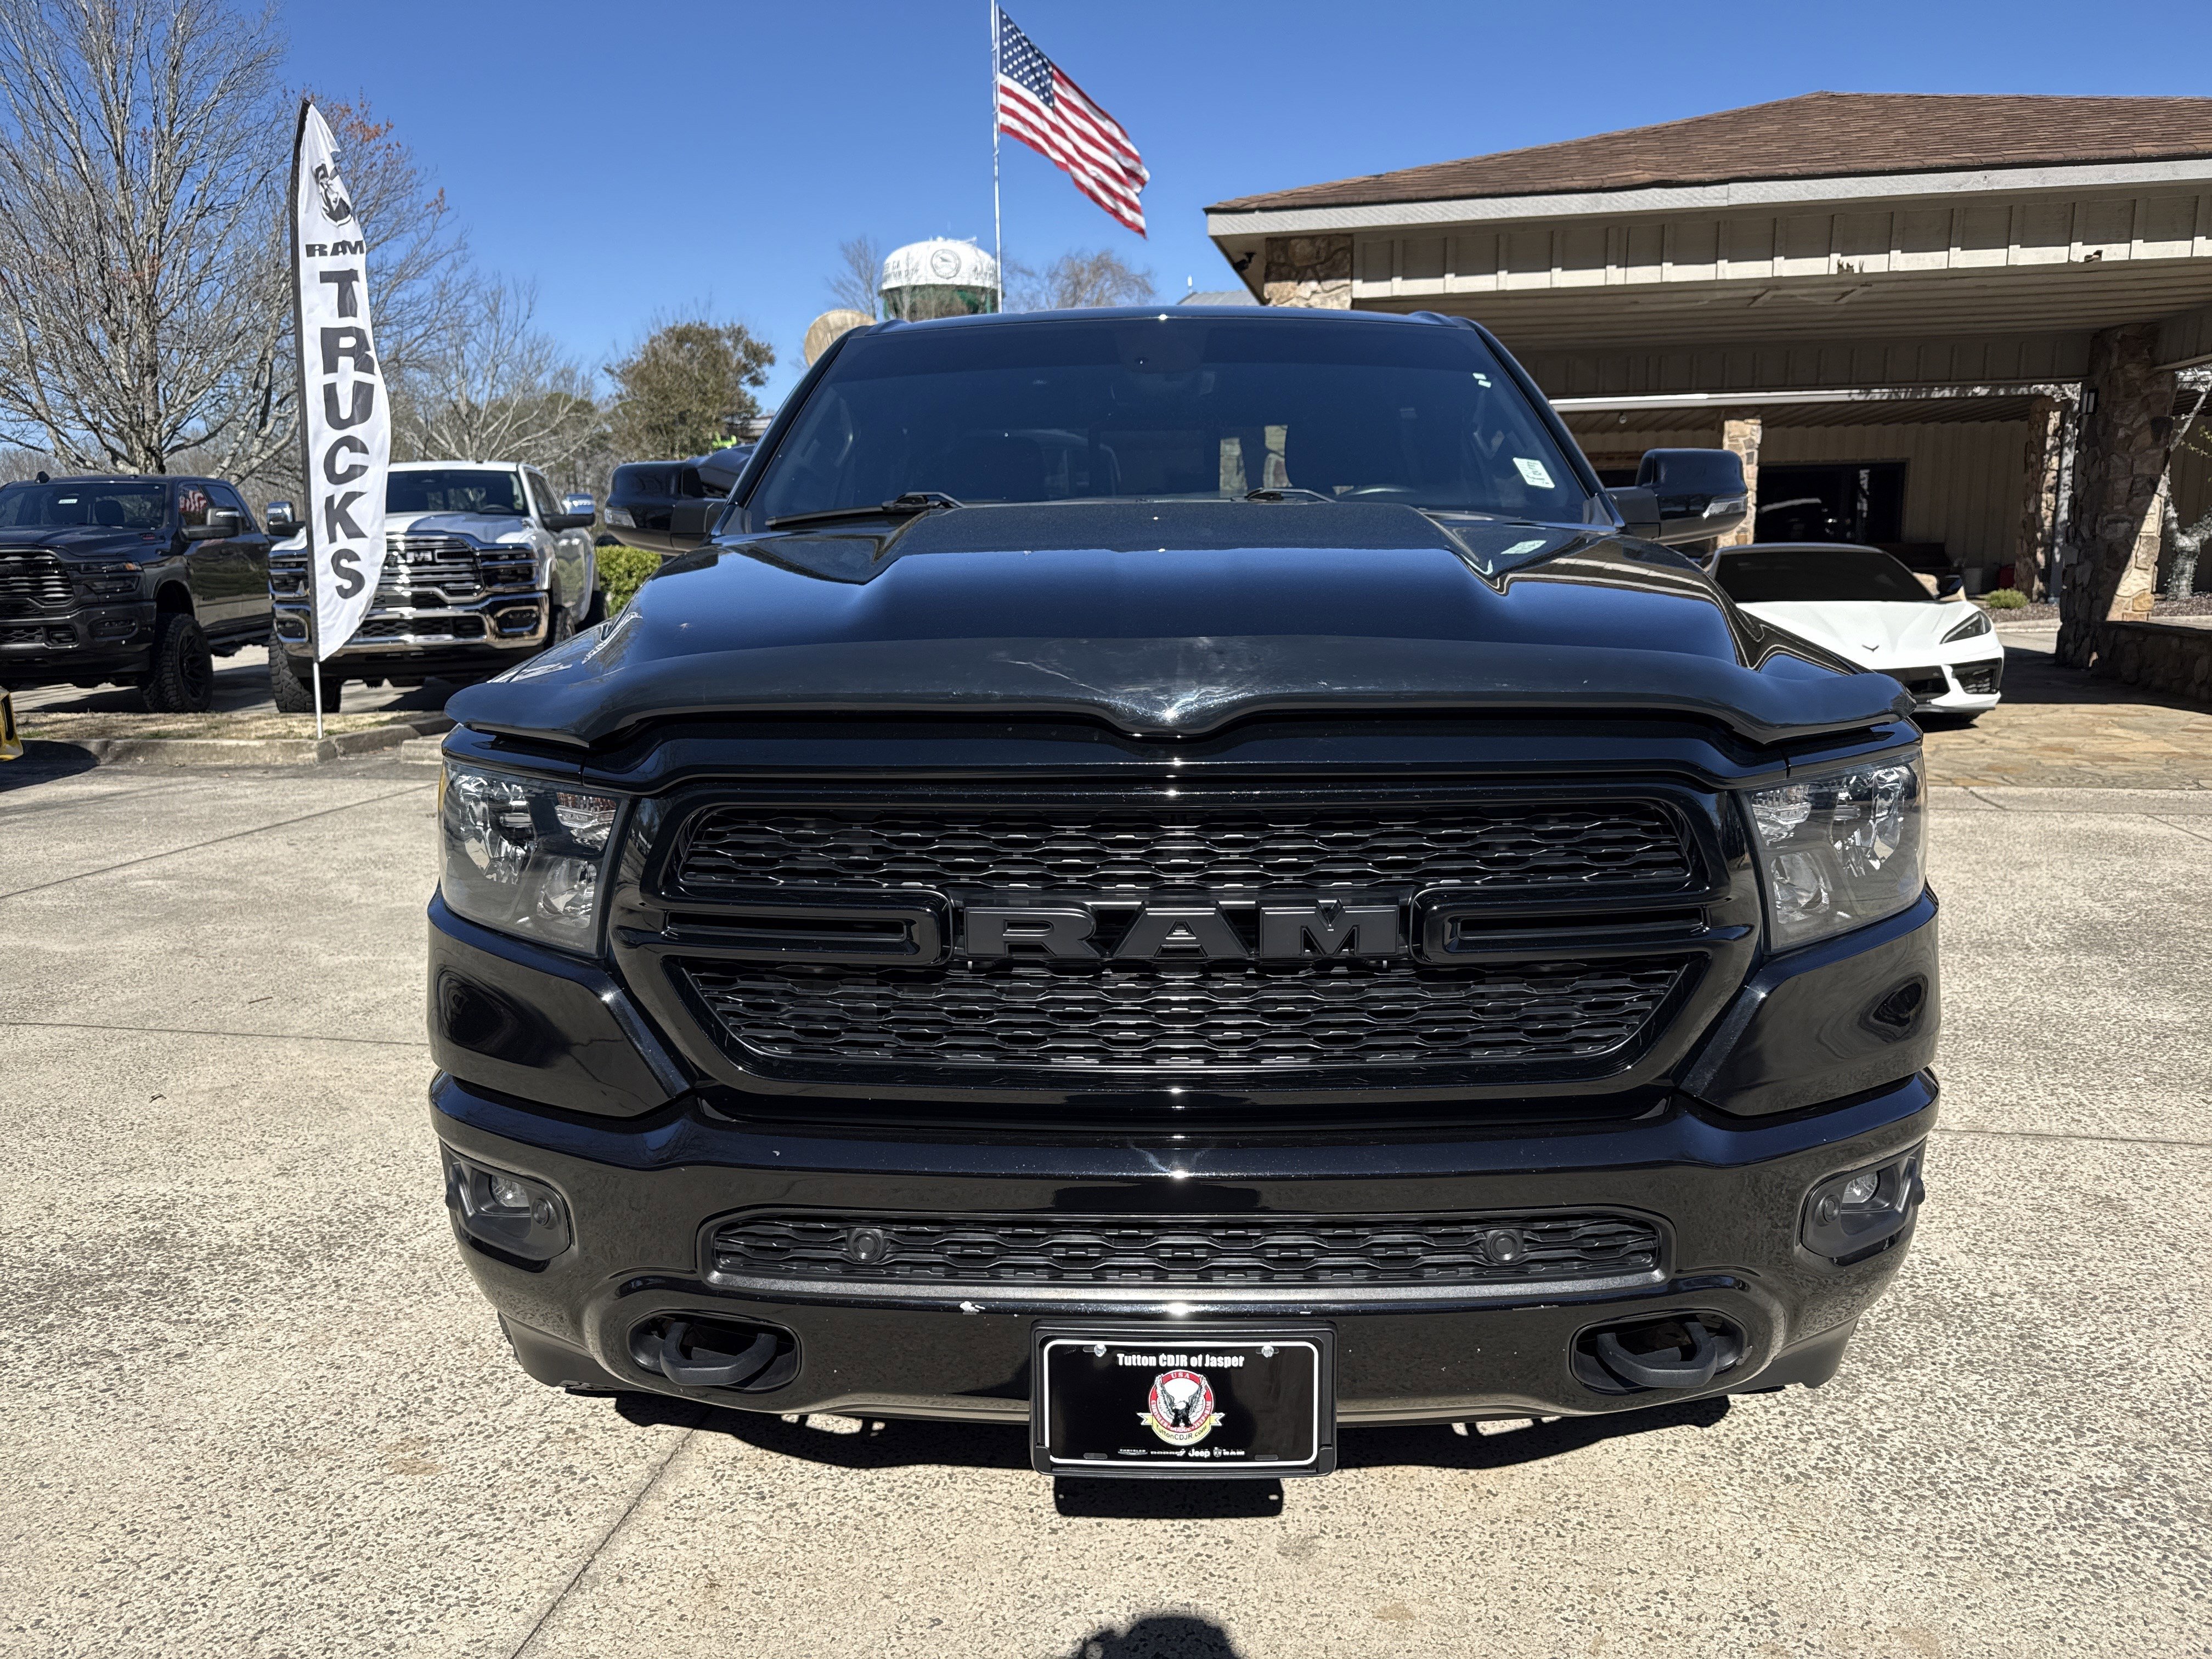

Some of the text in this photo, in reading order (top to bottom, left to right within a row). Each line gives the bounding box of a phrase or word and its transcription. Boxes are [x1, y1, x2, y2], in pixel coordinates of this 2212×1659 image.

[306, 240, 365, 258] RAM
[319, 269, 376, 599] TRUCKS
[964, 899, 1400, 958] RAM
[1117, 1353, 1245, 1368] Tutton CDJR of Jasper
[1155, 1424, 1207, 1441] TuttonCDJR.com
[1188, 1448, 1211, 1458] Jeep
